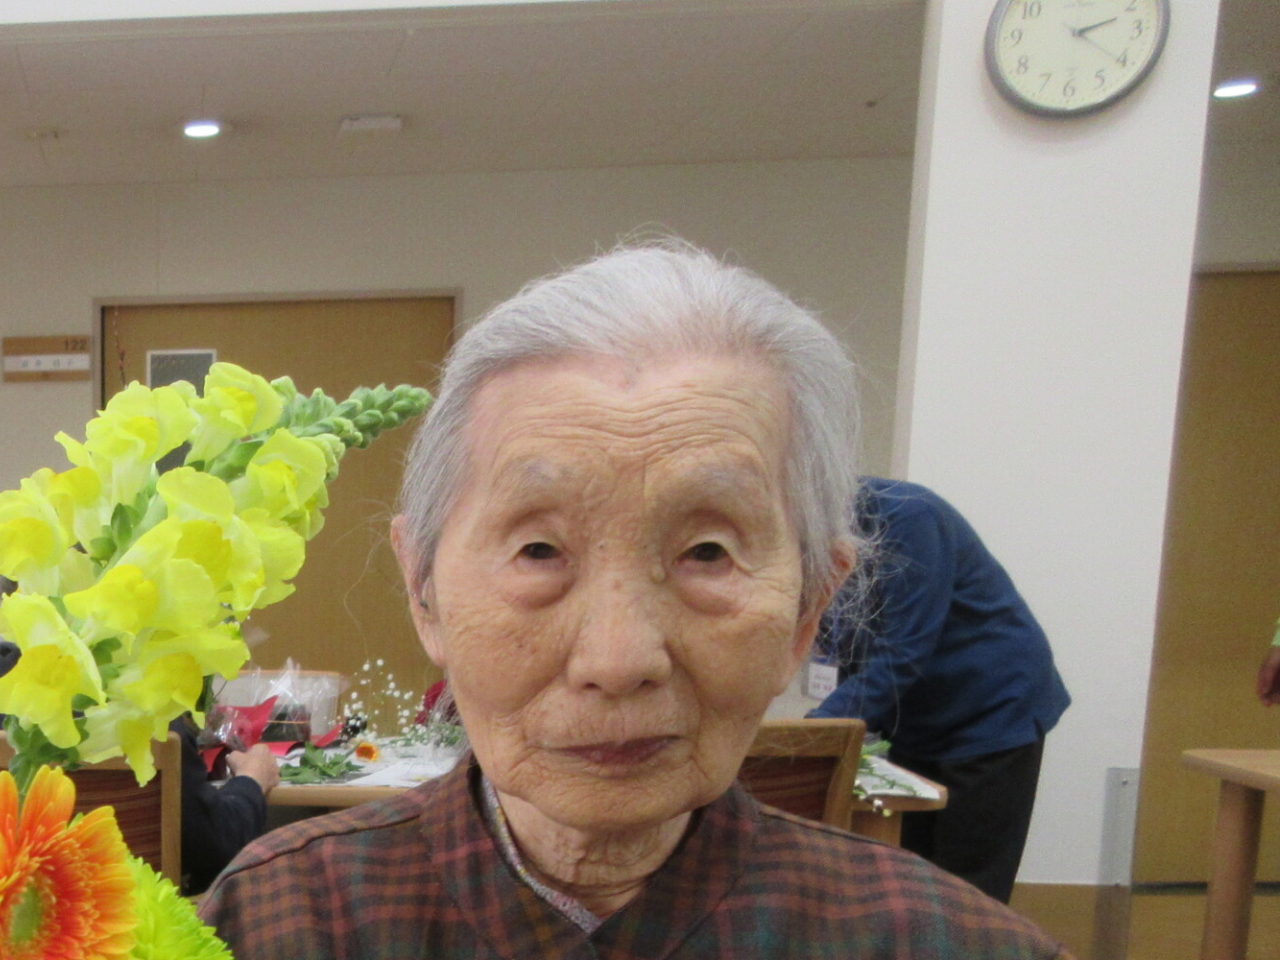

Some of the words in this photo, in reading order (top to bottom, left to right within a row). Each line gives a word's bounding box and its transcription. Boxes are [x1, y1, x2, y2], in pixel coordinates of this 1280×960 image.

[1010, 29, 1023, 47] 9
[1130, 20, 1143, 40] 3
[1016, 55, 1029, 75] 8
[1116, 49, 1128, 67] 4
[1039, 73, 1052, 93] 7
[1063, 78, 1075, 97] 6
[1094, 69, 1106, 90] 5
